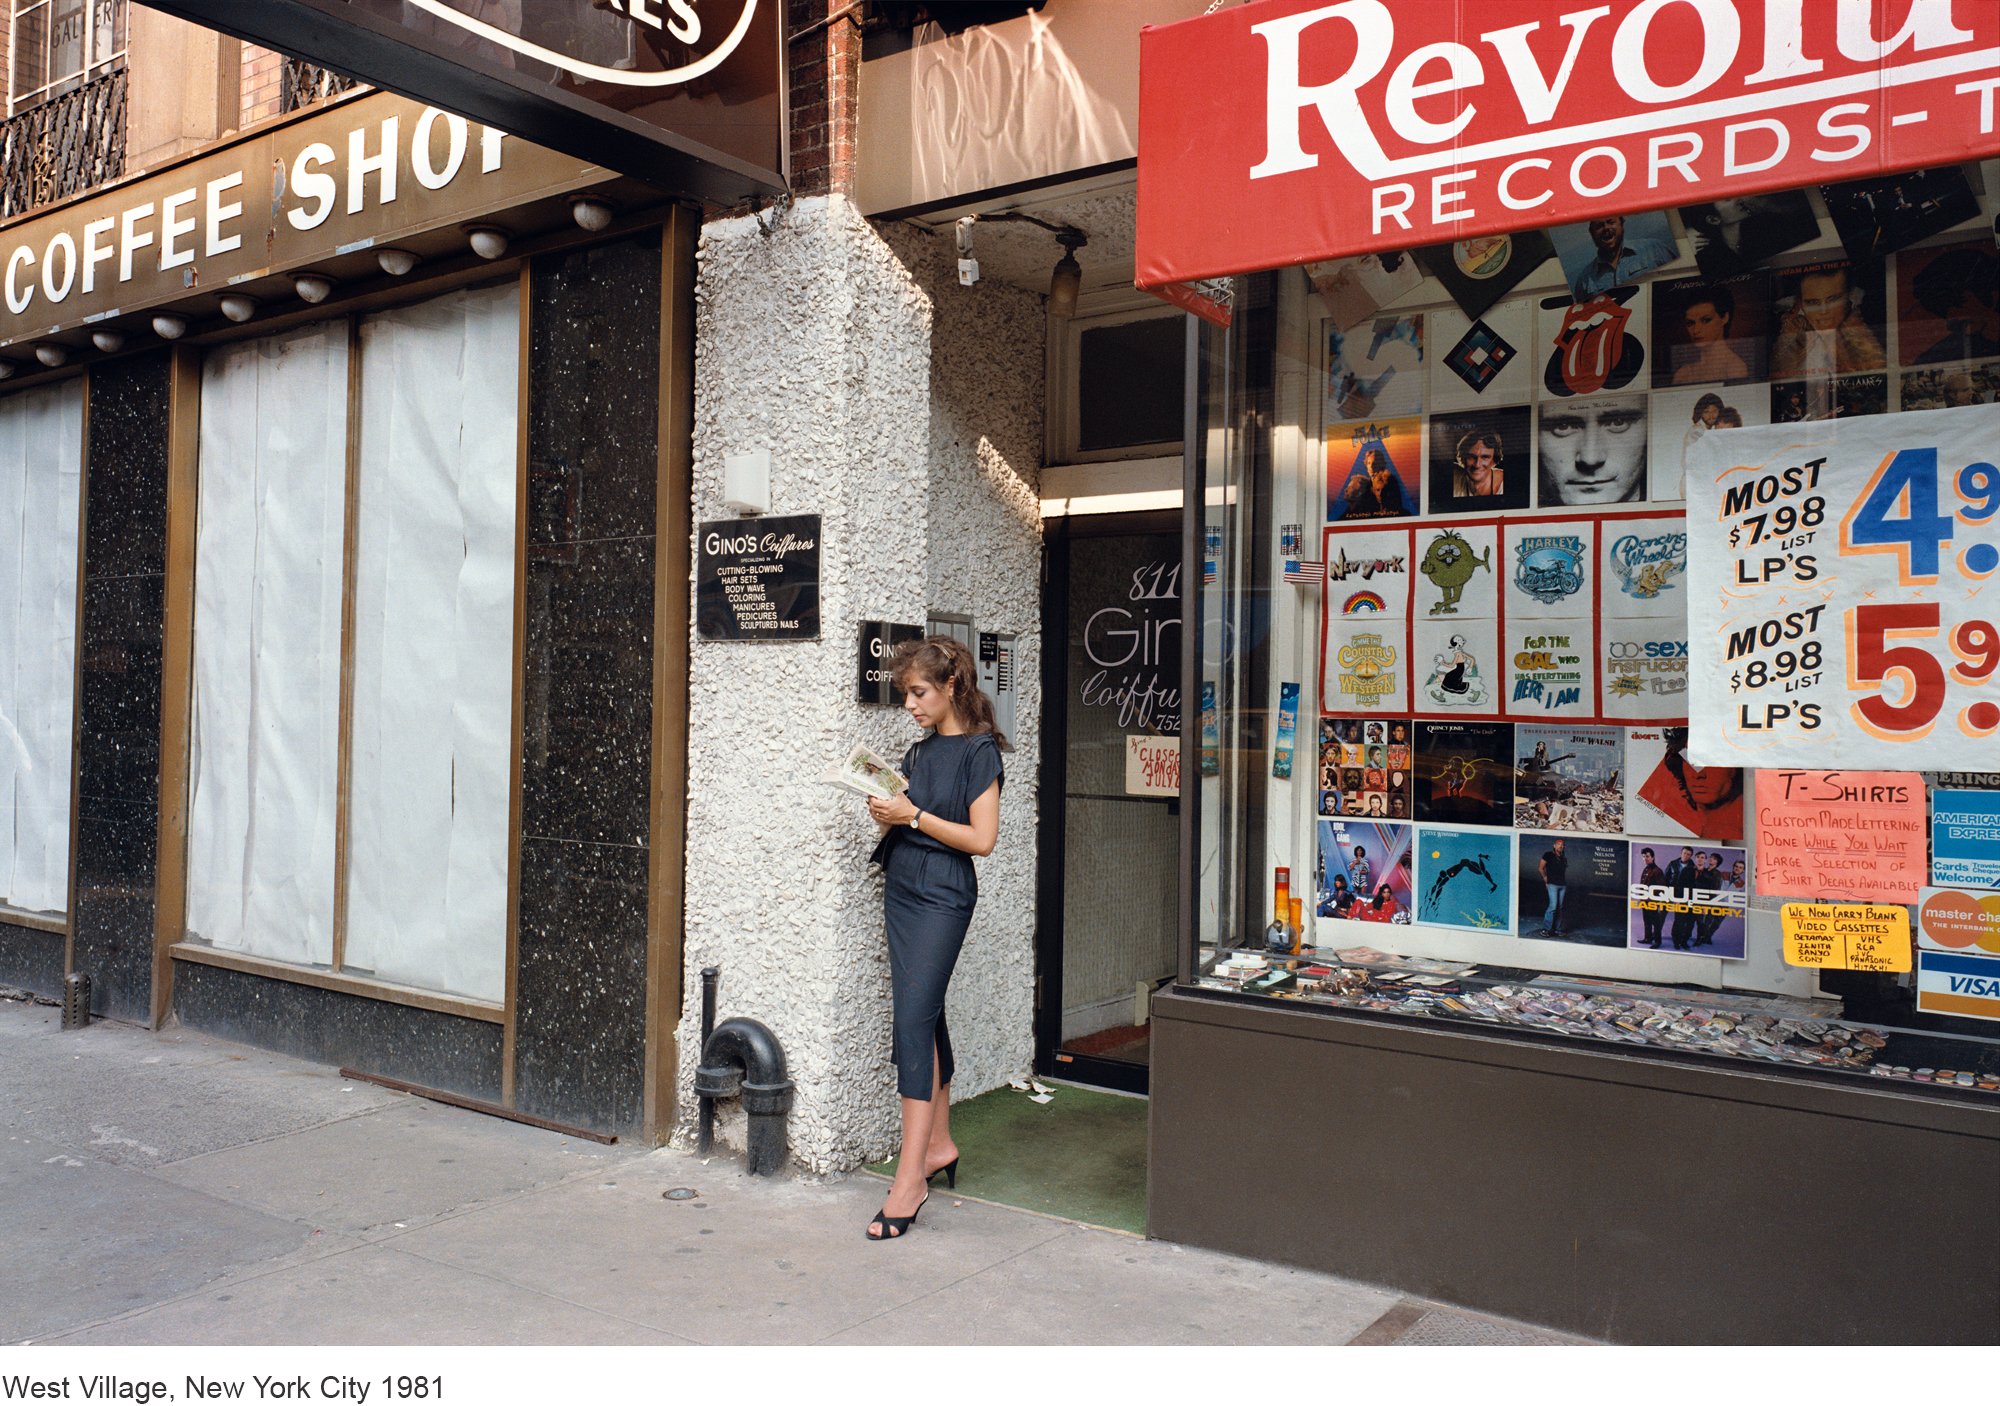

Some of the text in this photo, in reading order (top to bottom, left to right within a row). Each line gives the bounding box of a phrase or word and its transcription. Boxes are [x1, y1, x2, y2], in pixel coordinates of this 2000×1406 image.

[610, 0, 702, 45] ES
[4, 171, 243, 315] COFFEE
[1723, 457, 1828, 517] MOST
[1728, 496, 1826, 548] $7.98
[705, 532, 815, 559] GINO'S Coiffures
[1525, 537, 1576, 551] HARLEY
[1781, 531, 1817, 551] LIST
[717, 564, 784, 576] CUTTING-BLOWING
[1738, 553, 1818, 583] LP'S
[721, 575, 758, 584] HAIR SETS
[1129, 560, 1182, 601] 811
[725, 584, 766, 594] BODY WAVE
[728, 593, 766, 603] COLORING
[732, 602, 776, 612] MANICURES
[736, 611, 777, 621] PEDICURES
[740, 620, 799, 630] SCULPTURED NAILS
[1727, 604, 1826, 661] MOST
[1548, 635, 1570, 648] THE
[1644, 641, 1688, 657] sex
[1514, 651, 1580, 670] GAL WHO
[1730, 641, 1823, 693] $8.98
[1532, 672, 1581, 680] EVERYTHING
[1785, 671, 1823, 693] LIST
[1513, 680, 1544, 704] HERE
[1554, 687, 1580, 708] AM
[1740, 699, 1822, 730] LP'S
[1570, 735, 1616, 747] JOE WALSH
[1760, 807, 1921, 832] CUSTOM MADE LETTERING
[1763, 831, 1908, 852] DONE WHILE YOU WAIT
[1765, 853, 1906, 871] LARGE SELECTION OF
[1934, 862, 1969, 872] Cards
[1819, 872, 1855, 888] DECALS
[1859, 876, 1919, 891] AVAILABLE
[1934, 872, 1994, 884] Welcome
[1789, 906, 1897, 920] WE NOW CARRY BLANK
[1926, 908, 1974, 920] master
[1797, 920, 1889, 934] VIDEO CASSETTES
[1951, 923, 1995, 933] INTERBANK
[1794, 934, 1835, 942] BETAMAX
[1861, 936, 1882, 944] VHS
[1856, 943, 1875, 951] RCA
[1850, 955, 1893, 964] PANASONIC
[1854, 963, 1888, 971] HITACHI
[1949, 975, 2000, 997] VISA
